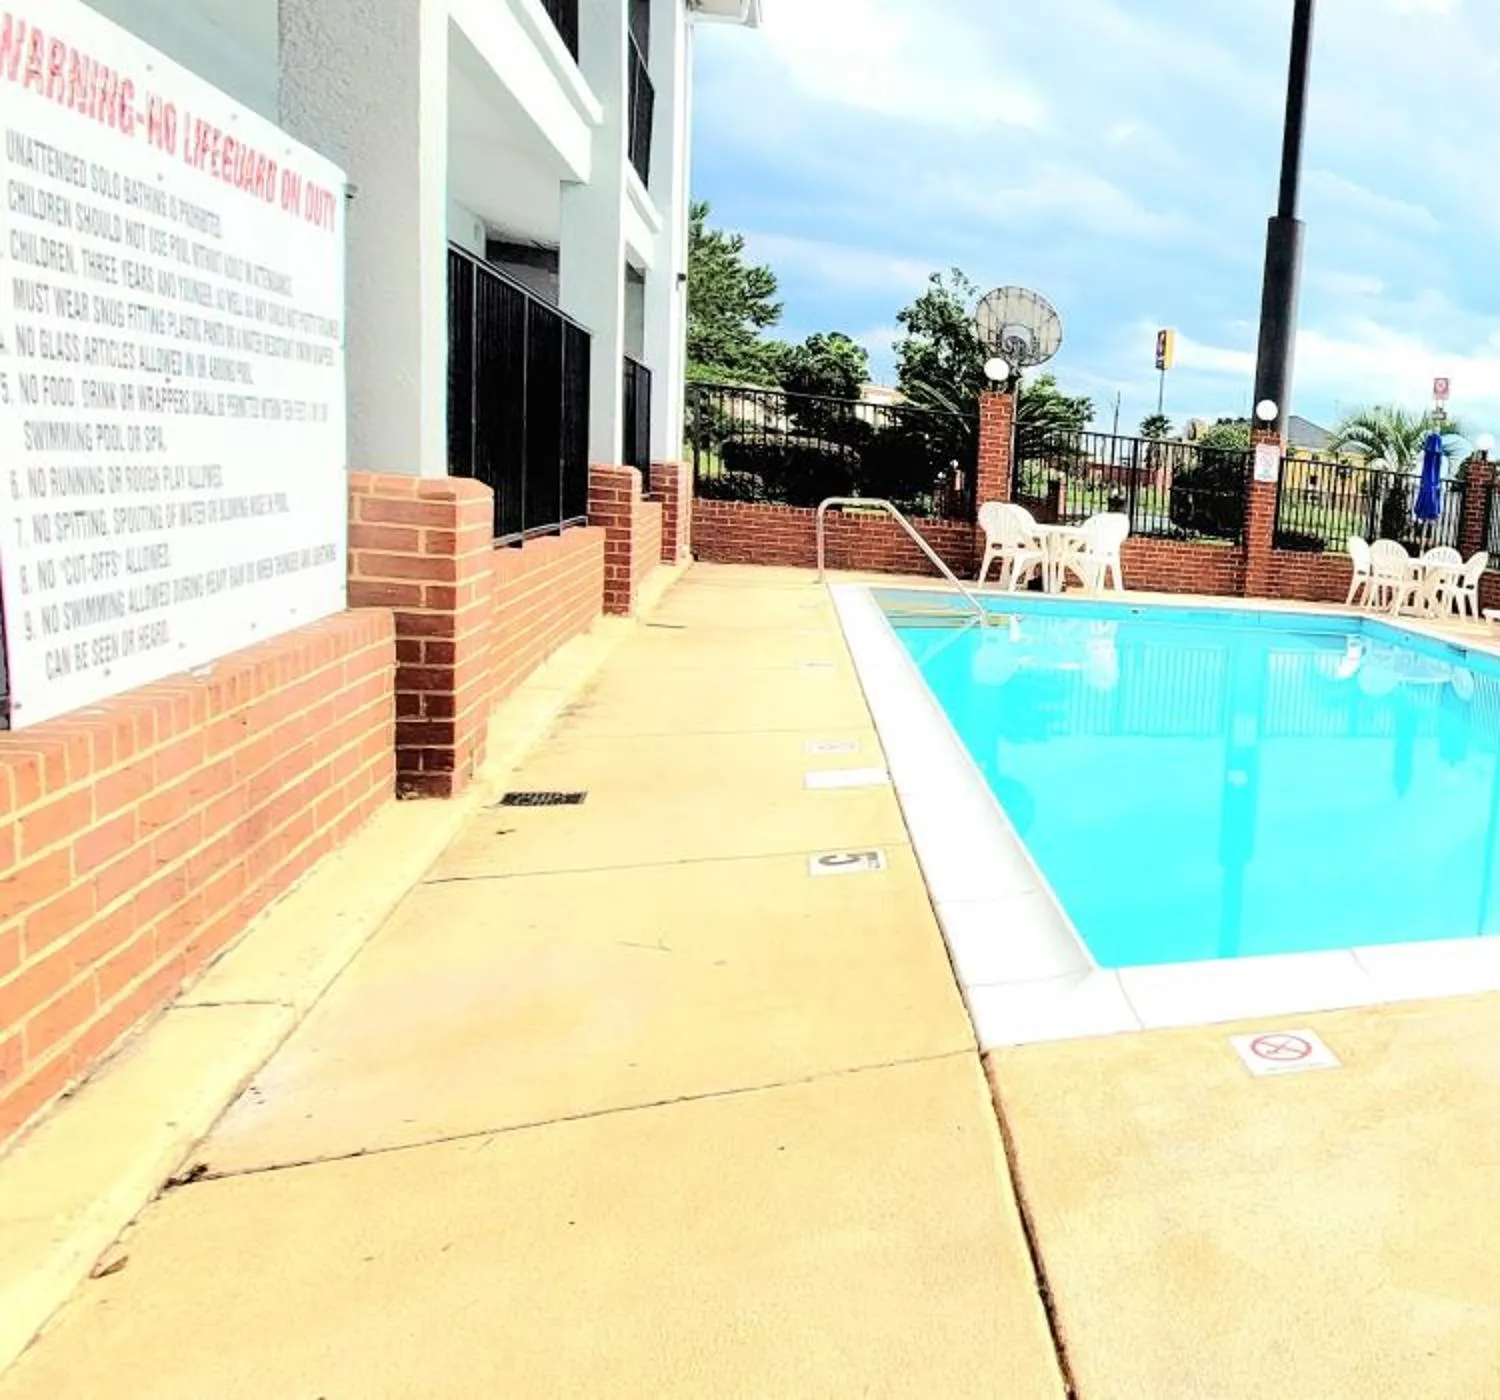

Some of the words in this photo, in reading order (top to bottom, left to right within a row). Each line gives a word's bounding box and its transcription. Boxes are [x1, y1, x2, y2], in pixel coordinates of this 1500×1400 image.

[4, 128, 87, 190] UNATTENDED
[89, 162, 120, 202] SOLO
[183, 110, 277, 203] LIFEGUARD
[281, 168, 301, 217] ON
[304, 181, 337, 233] DUTY
[6, 178, 72, 231] CHILDREN
[74, 201, 121, 246] SHOULD
[124, 218, 146, 253] NOT
[148, 226, 168, 260] USE
[81, 248, 118, 285] THREE
[121, 259, 155, 294] YEARS
[156, 268, 176, 300] AND
[11, 277, 50, 316] MUST
[54, 286, 89, 323] WEAR
[92, 294, 125, 330] SNUG
[127, 302, 165, 337] FITTING
[14, 325, 35, 358] NO
[38, 329, 81, 364] GLASS
[83, 336, 135, 370] ARTICLES
[138, 344, 182, 376] ALLOWED
[18, 373, 39, 405] NO
[81, 379, 116, 410] DRINK
[119, 383, 134, 411] OR
[137, 385, 189, 414] WRAPPERS
[23, 421, 93, 452] SWIMMING
[96, 423, 124, 451] POOL
[126, 424, 142, 451] OR
[27, 468, 47, 498] NO
[49, 466, 105, 497] RUNNING
[107, 466, 121, 494] OR
[124, 465, 160, 493] ROUGH
[162, 464, 185, 491] PLAY
[32, 513, 52, 545] NO
[112, 503, 162, 535] SPOUTING
[165, 502, 177, 528] OF
[37, 558, 56, 591] NO
[41, 603, 60, 636] NO
[62, 589, 125, 631] SWIMMING
[127, 579, 170, 615] ALLOWED
[45, 646, 70, 680] CAN
[73, 641, 89, 672] BE
[91, 632, 119, 666] SEEN
[121, 628, 135, 657] OR
